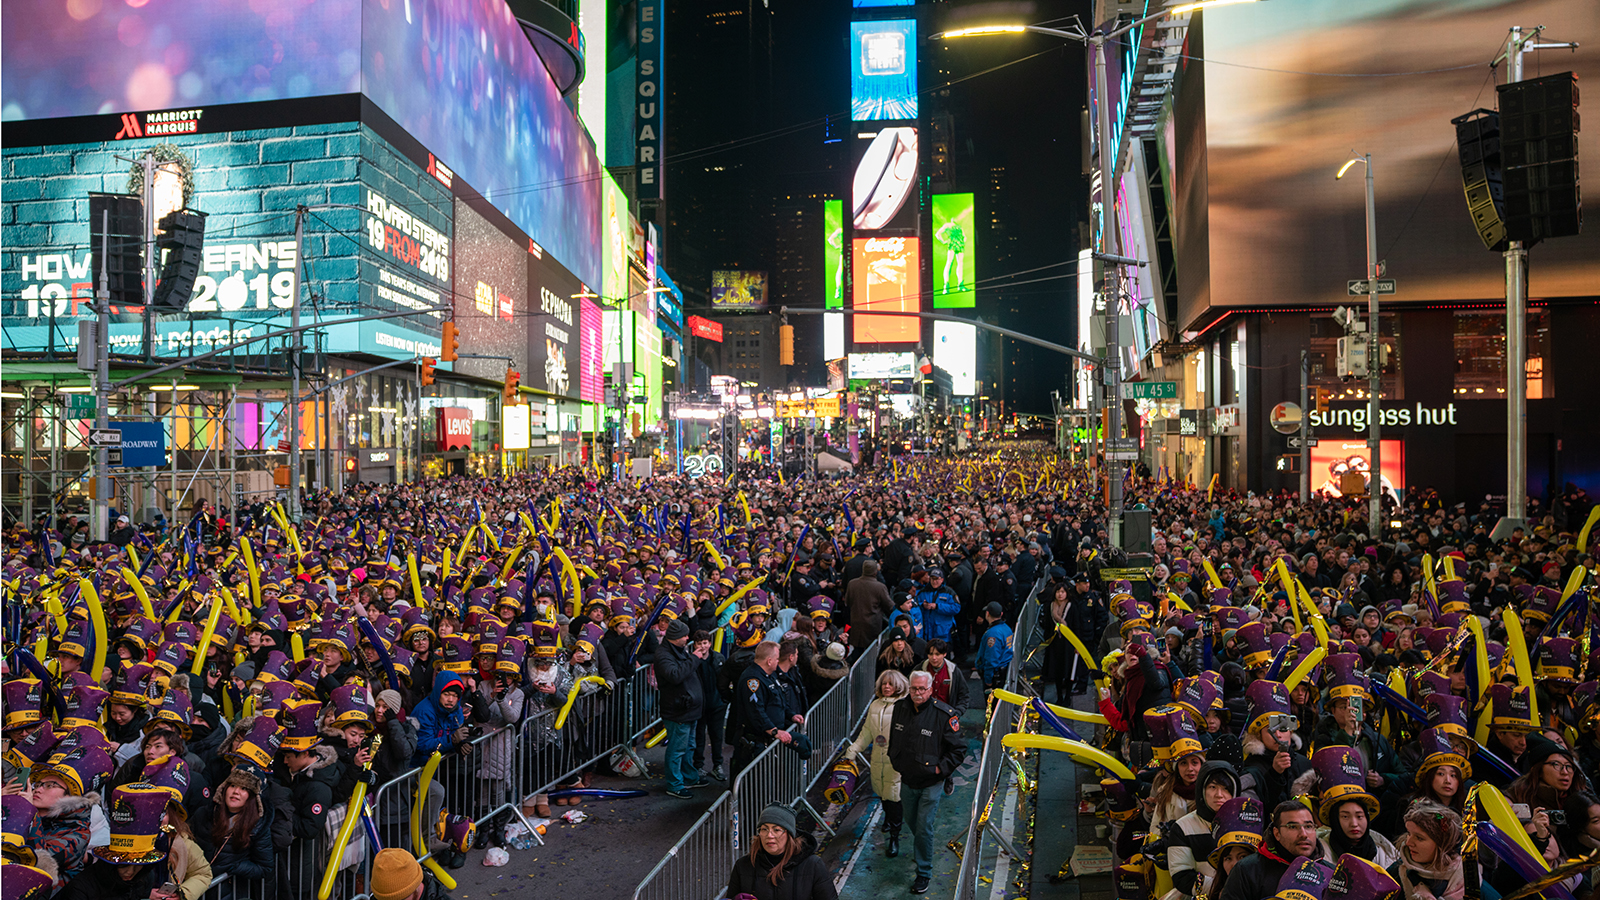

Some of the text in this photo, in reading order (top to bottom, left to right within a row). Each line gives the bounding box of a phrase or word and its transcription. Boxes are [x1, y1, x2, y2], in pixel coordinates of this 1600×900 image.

[639, 0, 656, 184] ES SQUARE
[147, 110, 203, 123] MARRIOTT
[147, 122, 195, 134] MARQUIS
[367, 216, 385, 251] 19
[384, 225, 420, 269] FROM
[203, 241, 297, 272] ERN'S
[21, 283, 67, 318] 19
[541, 286, 573, 327] SEPHORA
[109, 335, 141, 347] NOW
[1136, 385, 1145, 397] W
[1150, 385, 1162, 397] 45
[69, 410, 77, 418] W
[79, 409, 88, 418] 45
[1309, 402, 1457, 432] sunglass hut
[684, 455, 724, 478] 20
[1296, 871, 1318, 879] planet
[1297, 875, 1320, 885] fitness
